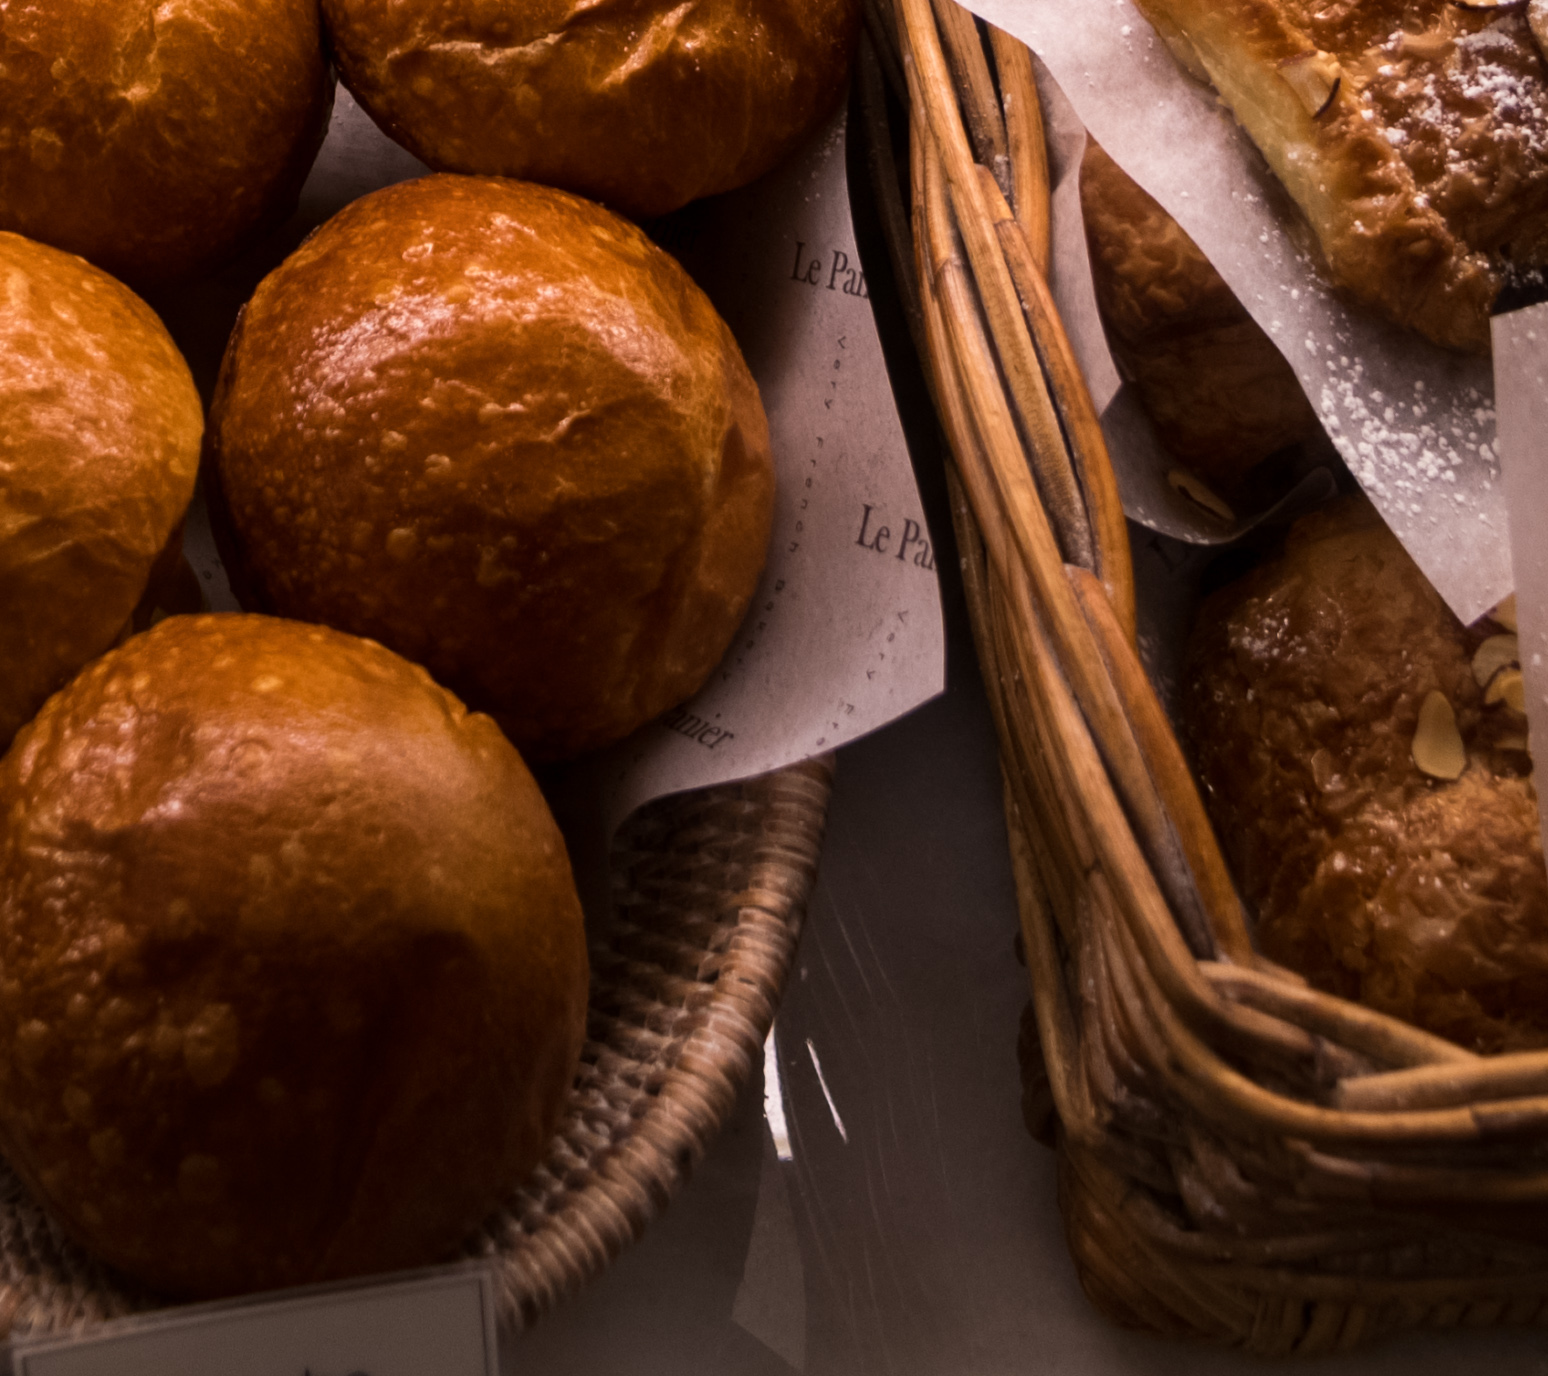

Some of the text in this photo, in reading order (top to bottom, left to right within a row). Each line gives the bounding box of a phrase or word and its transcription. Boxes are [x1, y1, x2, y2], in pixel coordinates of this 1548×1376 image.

[790, 241, 822, 286] Le
[823, 335, 847, 410] Very
[789, 436, 825, 553] French
[855, 503, 890, 554] Le
[866, 608, 910, 681] Very
[661, 704, 735, 750] anier
